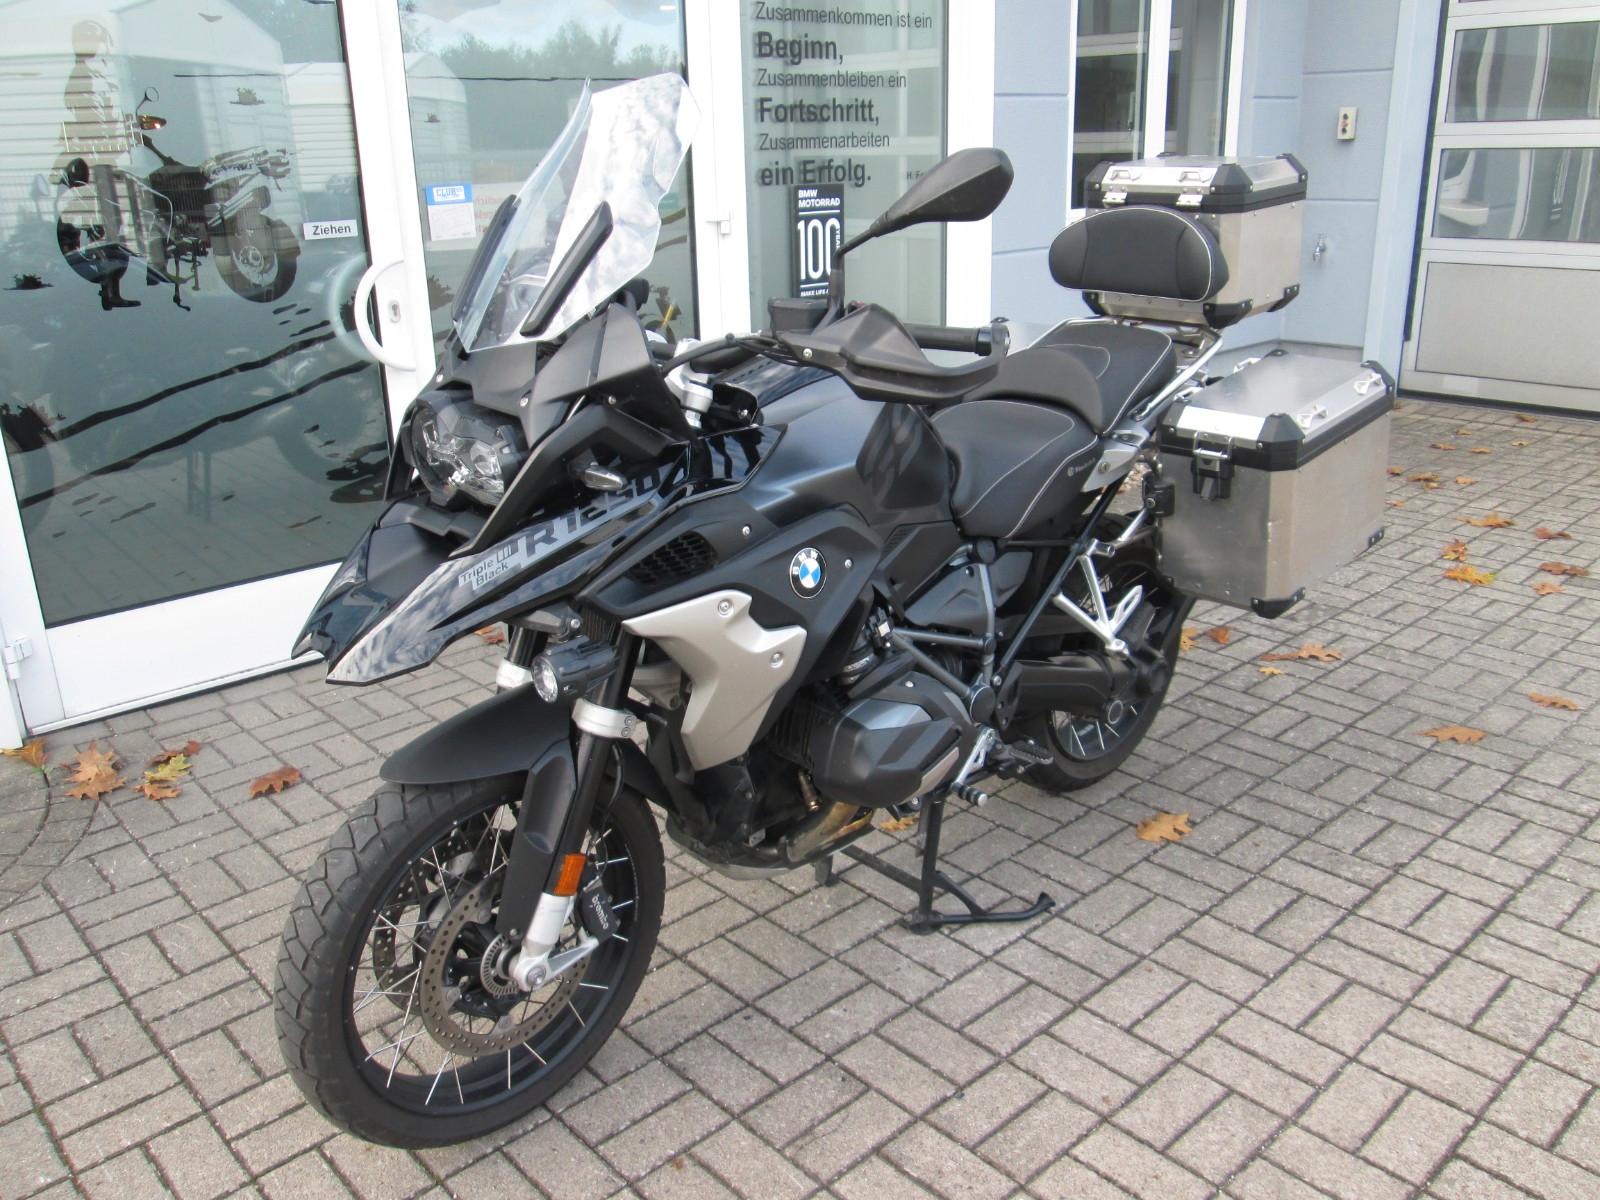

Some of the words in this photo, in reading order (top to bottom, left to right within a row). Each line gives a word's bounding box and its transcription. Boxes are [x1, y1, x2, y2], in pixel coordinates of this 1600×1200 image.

[755, 1, 893, 26] Zusammenkommen
[897, 11, 910, 28] ist
[914, 13, 932, 29] ein
[757, 31, 843, 65] Beginn,
[757, 68, 884, 88] Zusammenbleiben
[888, 72, 907, 88] ein
[759, 97, 879, 126] Fortschritt,
[759, 132, 890, 150] Zusammenarbeiten
[760, 161, 794, 186] ein
[801, 158, 871, 187] Erfolg.
[798, 189, 819, 198] BMW
[798, 198, 841, 208] MOTORRAD
[311, 224, 352, 236] Ziehen
[797, 218, 841, 280] 100
[459, 559, 494, 583] Triple
[476, 561, 509, 586] Black
[592, 893, 609, 930] brembo
